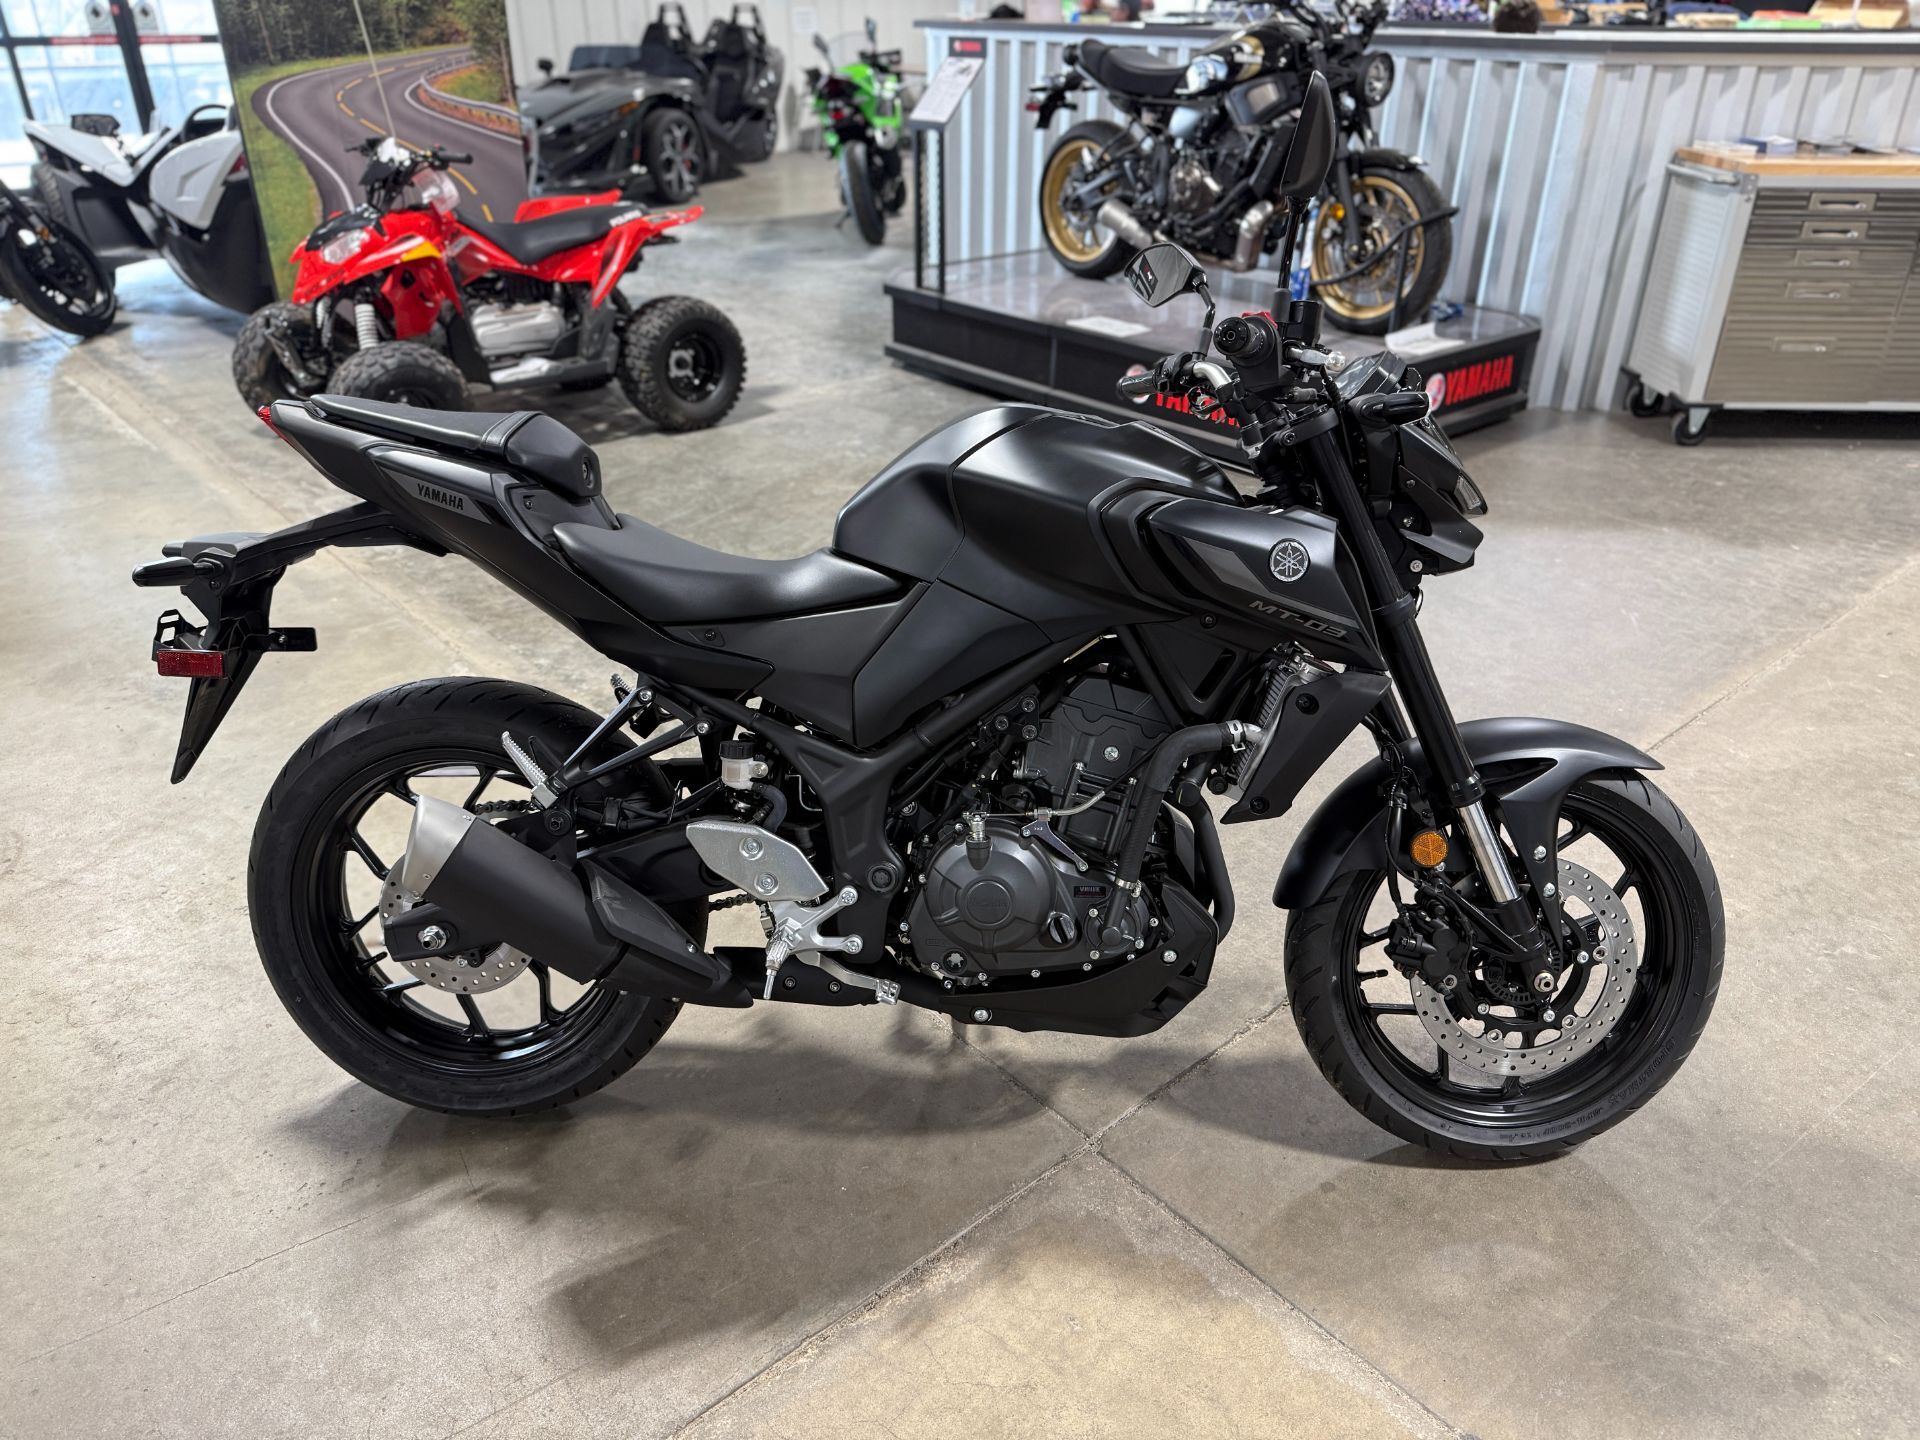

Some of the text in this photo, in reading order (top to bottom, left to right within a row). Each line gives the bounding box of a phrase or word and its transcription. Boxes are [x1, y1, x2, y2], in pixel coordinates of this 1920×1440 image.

[1444, 354, 1514, 406] YAMAHA
[417, 483, 464, 511] YAMAHA
[1248, 600, 1347, 638] MT-03
